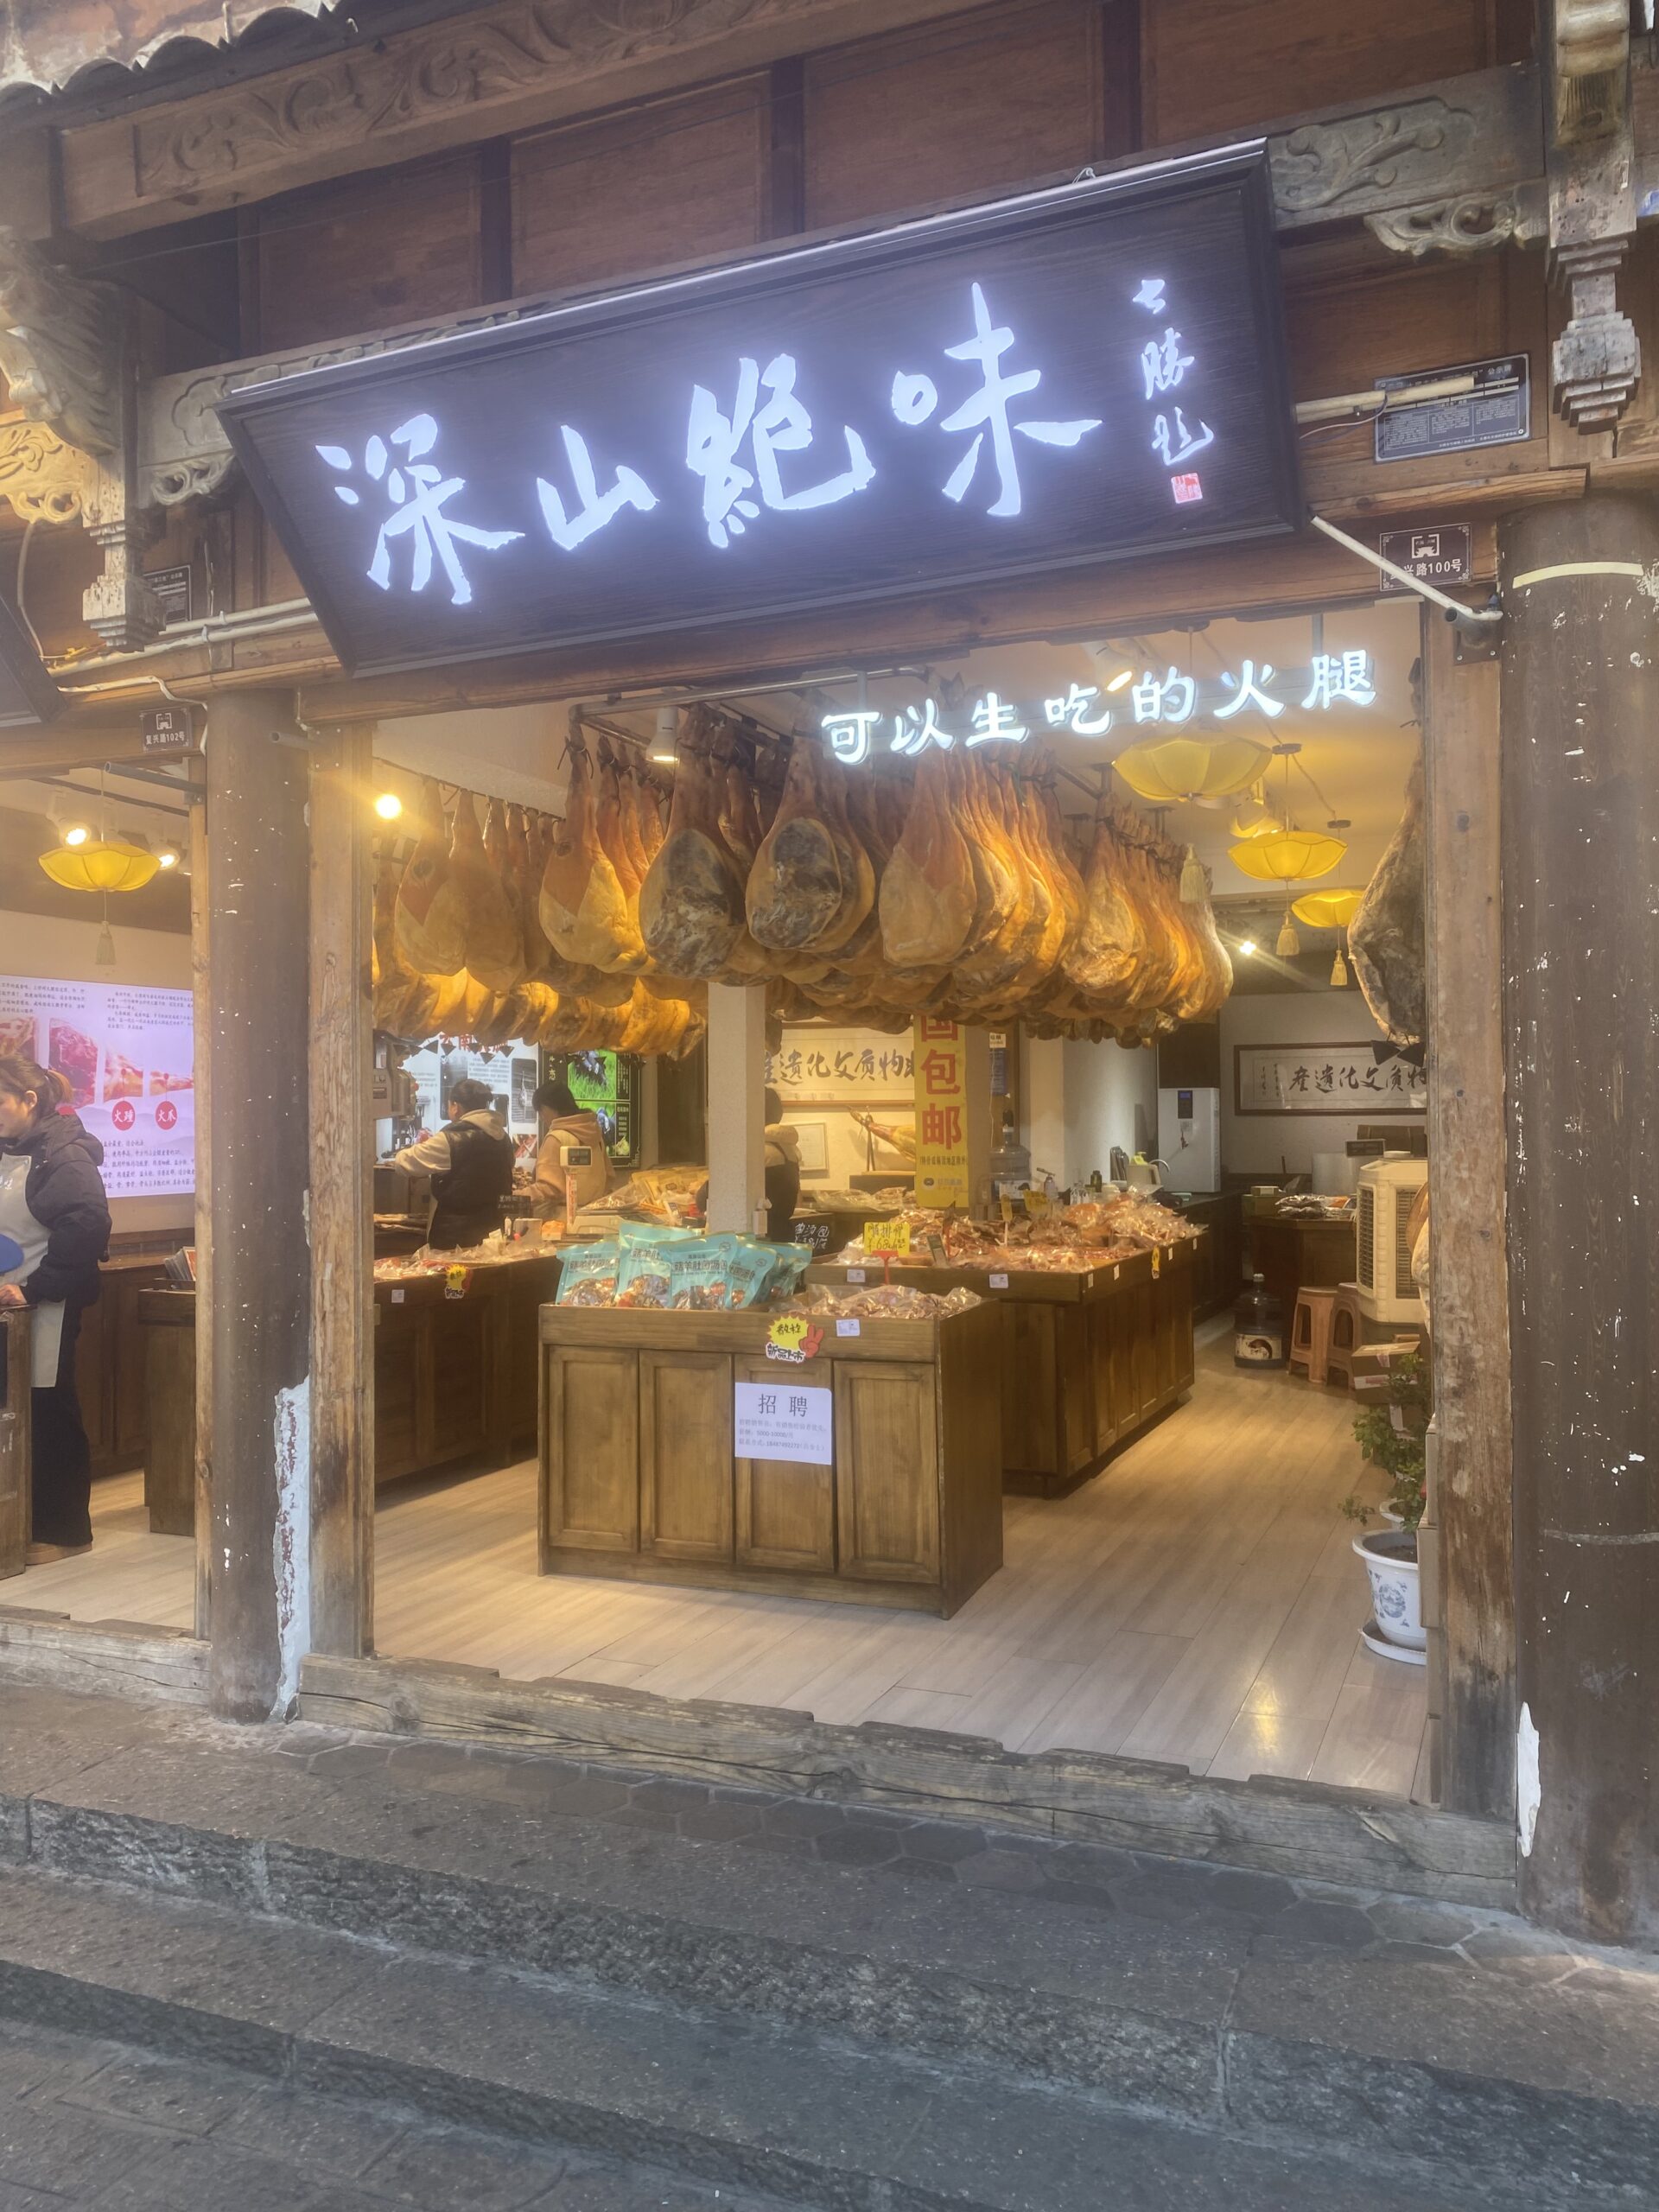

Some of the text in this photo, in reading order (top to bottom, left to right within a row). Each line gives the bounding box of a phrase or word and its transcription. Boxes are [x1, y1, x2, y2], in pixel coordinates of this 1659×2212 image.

[821, 649, 1377, 765] 可以生吃的火腿
[145, 731, 186, 745] 复兴路102号
[766, 1342, 804, 1362] 新品上市
[758, 1393, 809, 1418] 招聘
